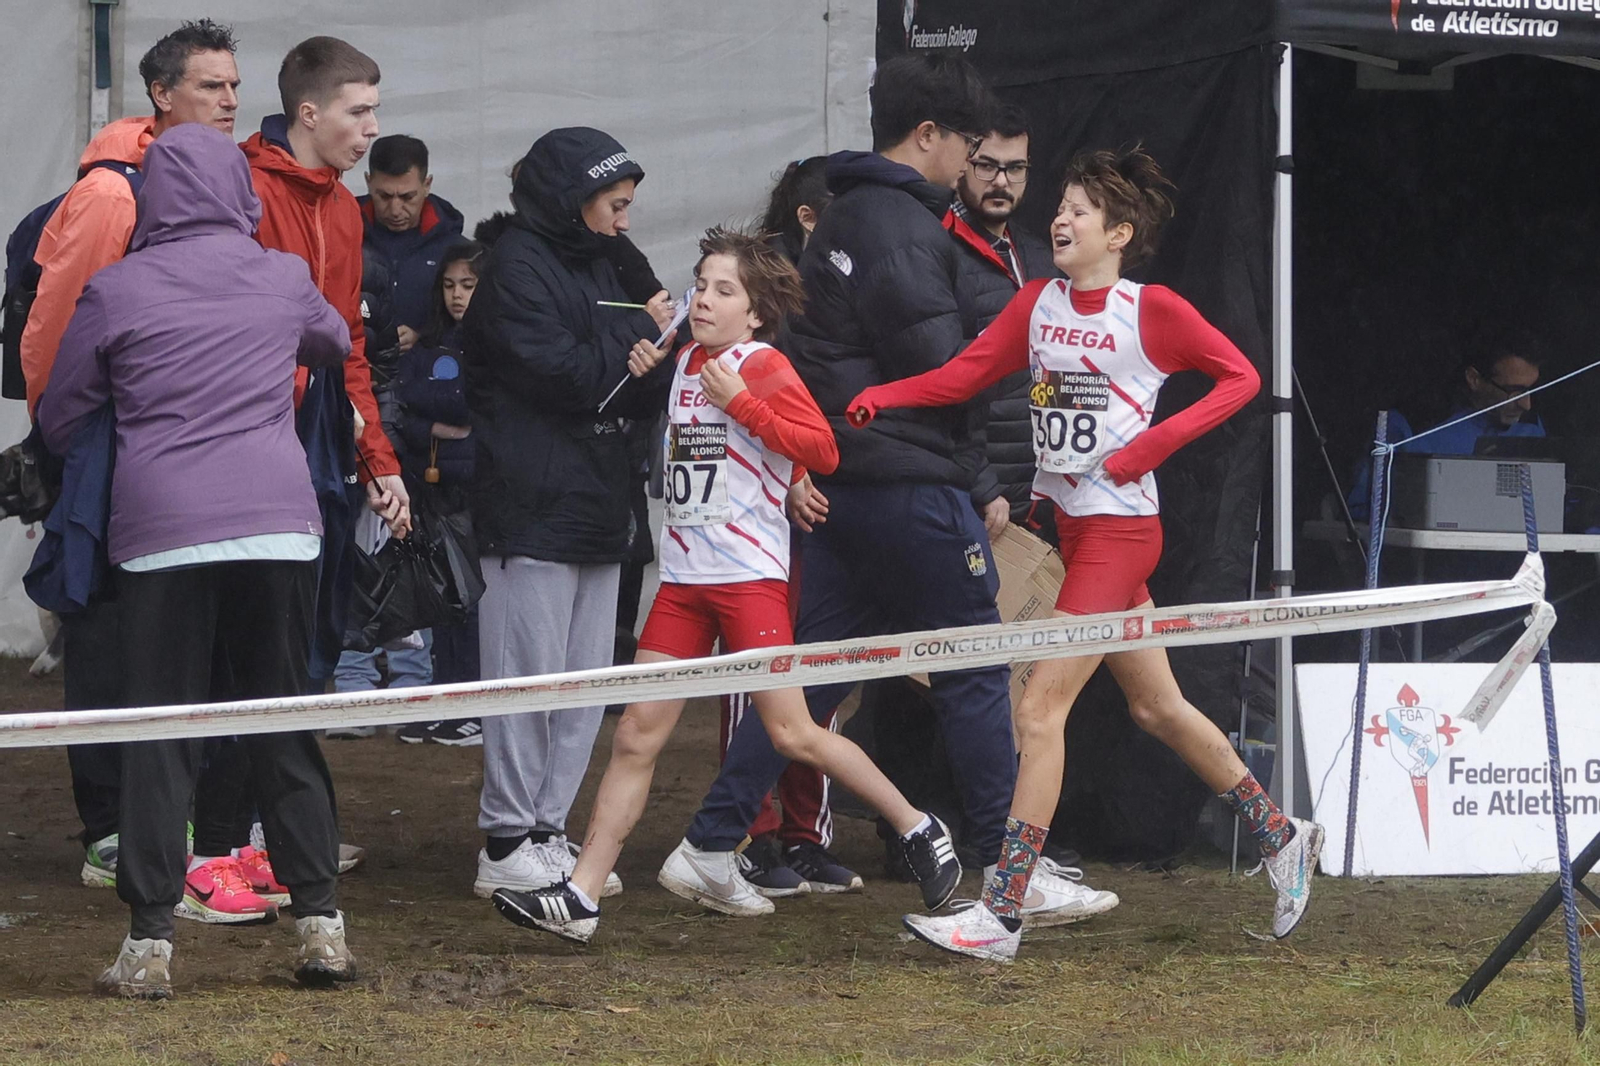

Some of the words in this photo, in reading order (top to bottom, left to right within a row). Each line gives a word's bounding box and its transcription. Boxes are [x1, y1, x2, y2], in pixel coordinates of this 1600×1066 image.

[1411, 0, 1529, 9] racin
[1411, 14, 1436, 33] de
[1442, 11, 1560, 38] Atletismo
[1038, 323, 1117, 353] TREGA
[1064, 374, 1110, 385] MEMORIAL
[1060, 385, 1110, 396] BELARMINO
[675, 389, 709, 408] EG
[1072, 396, 1107, 406] ALONSO
[680, 426, 727, 436] MEMORIAL
[1031, 409, 1097, 454] 308
[678, 436, 727, 446] BELARMINO
[690, 446, 725, 456] ALONSO
[1031, 629, 1059, 646] DE
[1066, 623, 1114, 642] VIGO
[847, 655, 861, 665] de
[1399, 709, 1424, 722] FGA
[1448, 757, 1577, 785] Federacin
[1452, 795, 1478, 816] de
[1487, 788, 1600, 816] Atletsm
